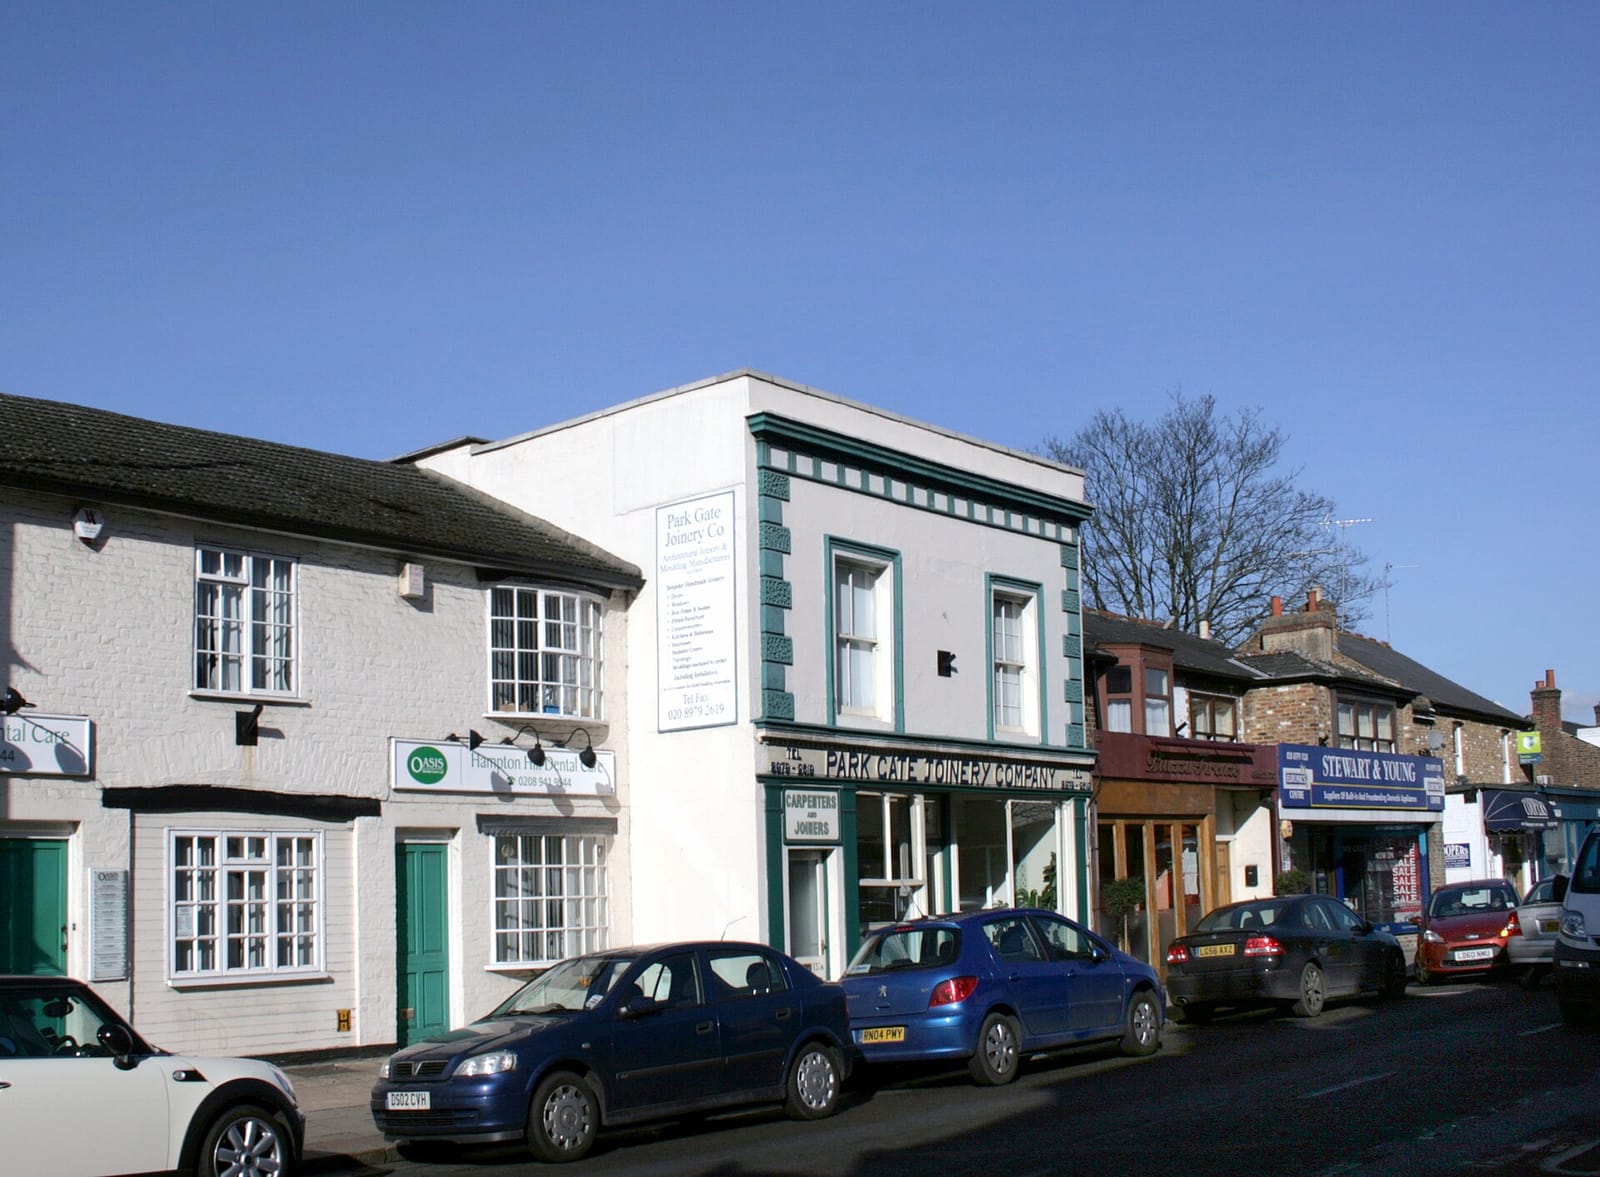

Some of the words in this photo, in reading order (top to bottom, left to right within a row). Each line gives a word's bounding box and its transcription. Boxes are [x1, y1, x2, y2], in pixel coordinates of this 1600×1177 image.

[667, 510, 692, 529] Park
[694, 507, 721, 523] Gate
[665, 529, 704, 547] Joinery
[707, 522, 724, 538] Co
[682, 693, 694, 704] Tel
[695, 692, 708, 703] Fax
[668, 708, 682, 720] 020
[684, 705, 703, 719] 8979
[705, 703, 725, 716] 2619
[32, 725, 71, 744] Care
[786, 747, 802, 761] TEL
[471, 752, 519, 773] Hampton
[544, 756, 578, 772] Dental
[826, 751, 871, 779] PARK
[877, 756, 918, 782] GATE
[924, 757, 991, 786] JOINERY
[995, 764, 1056, 789] COMPANY
[1322, 755, 1371, 779] STEWART
[1373, 759, 1382, 780] &
[1382, 760, 1416, 782] YOUNG
[518, 776, 537, 787] 0208
[786, 794, 837, 809] CARPENTERS
[794, 821, 829, 836] JOINERS
[1392, 867, 1416, 876] SALE
[1392, 876, 1416, 886] SALE
[1393, 886, 1417, 895] SALE
[1394, 895, 1417, 904] SALE
[863, 1029, 884, 1041] RN04
